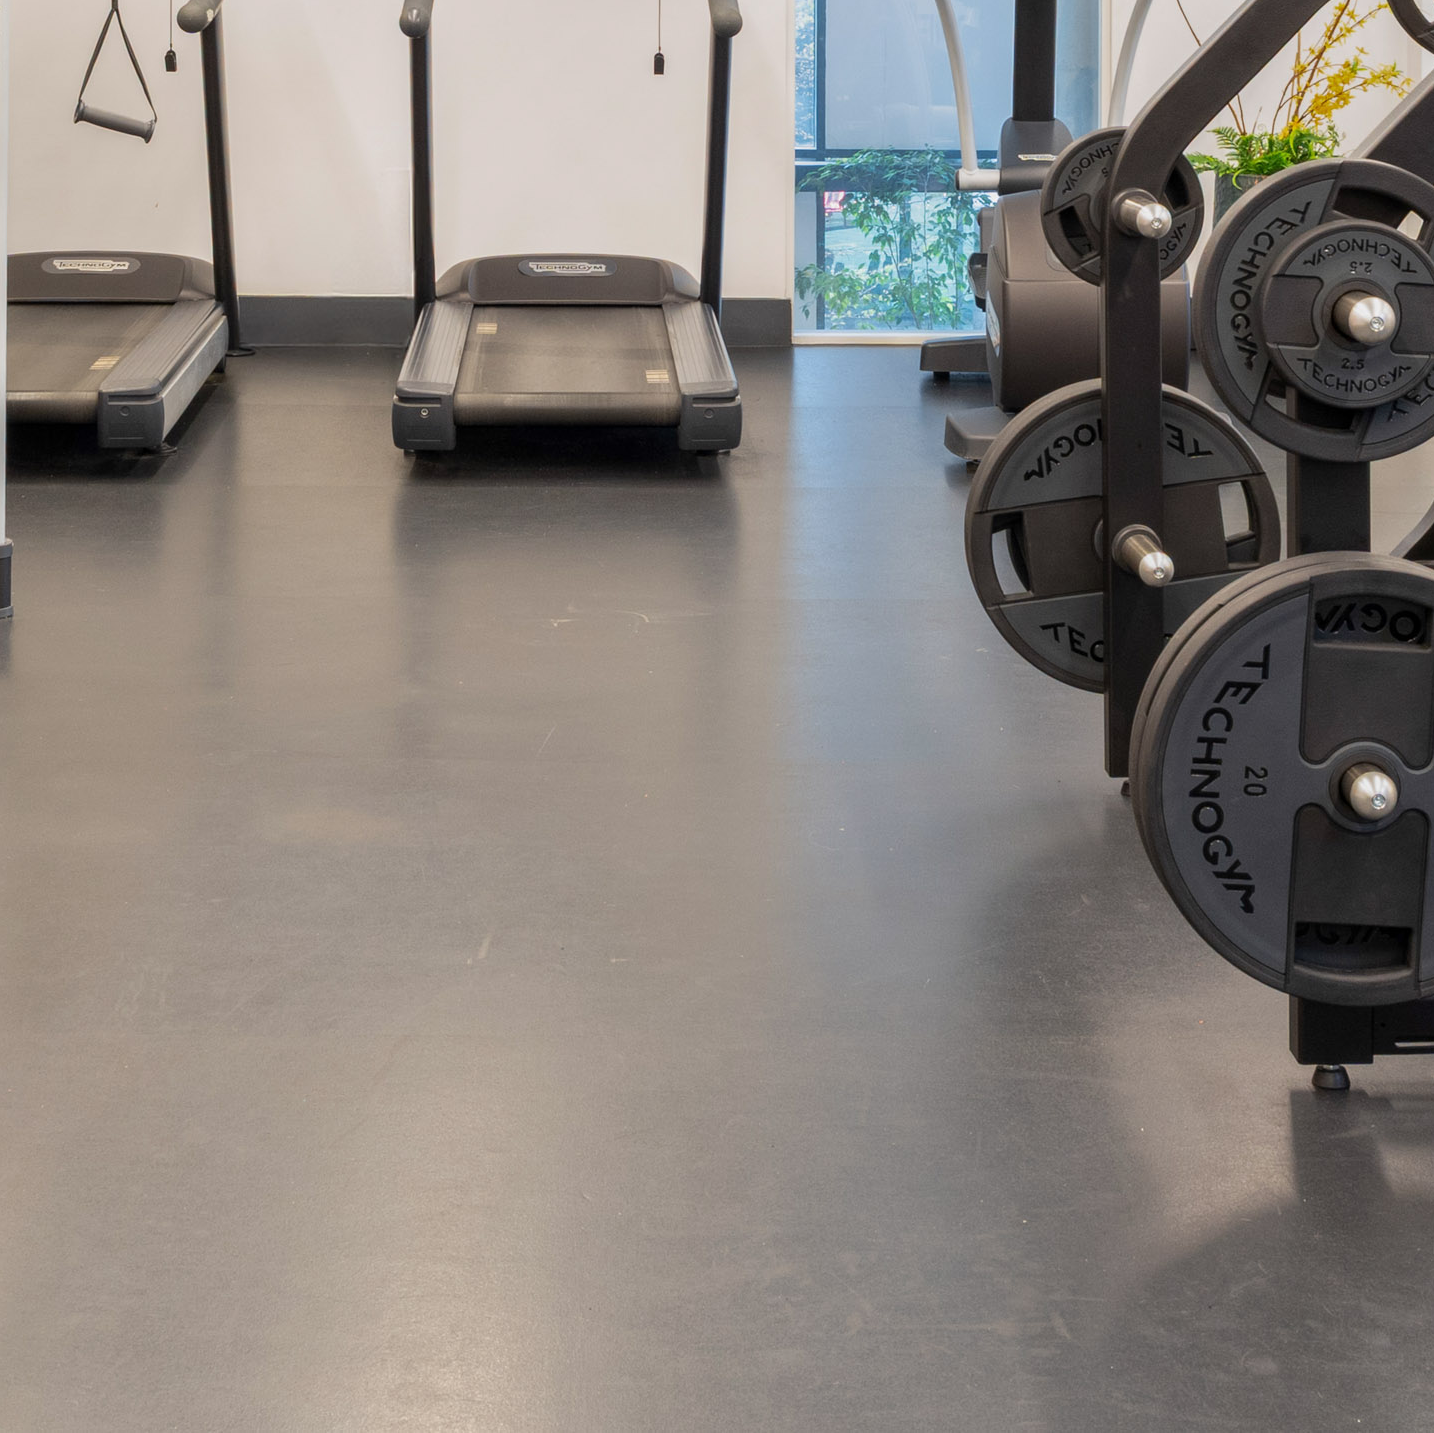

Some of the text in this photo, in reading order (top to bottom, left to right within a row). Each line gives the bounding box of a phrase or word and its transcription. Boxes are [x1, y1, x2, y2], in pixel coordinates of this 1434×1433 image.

[1062, 142, 1119, 196] HNOGYM
[1101, 167, 1109, 178] 5
[1302, 238, 1418, 275] TECHNOGYM
[1349, 261, 1374, 274] 2.5
[1229, 200, 1313, 372] TECHNOGYM
[1296, 356, 1413, 393] TECHNOGYM
[1341, 357, 1366, 370] 2.5
[1023, 419, 1214, 482] TEOGYM
[1189, 642, 1271, 914] TECHNOGYM
[1242, 765, 1268, 799] 20
